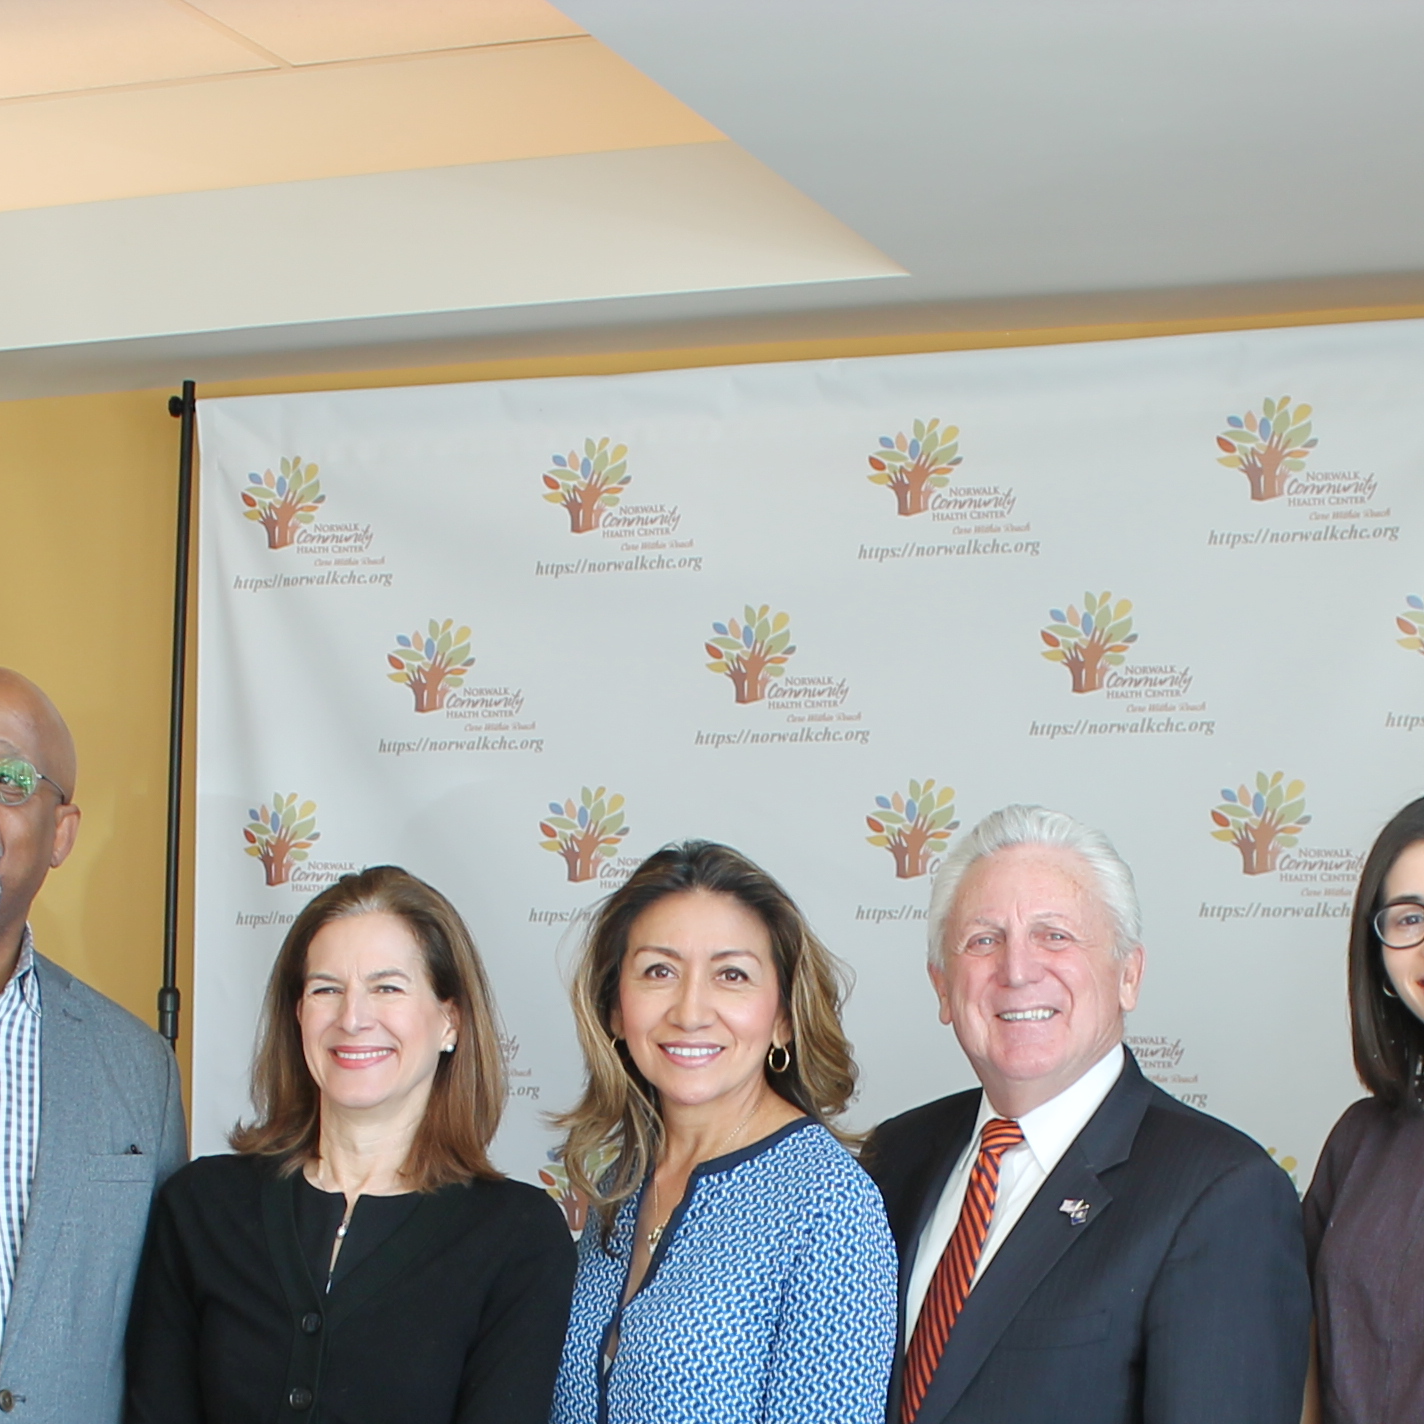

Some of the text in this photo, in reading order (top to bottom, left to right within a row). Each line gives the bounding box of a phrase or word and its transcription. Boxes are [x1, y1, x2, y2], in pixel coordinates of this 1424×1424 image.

[1306, 471, 1360, 481] NORWALK
[949, 486, 999, 496] NORWALK
[1287, 473, 1378, 499] Community
[931, 488, 1016, 515] Community
[1288, 496, 1365, 506] HEALTH CENTER
[620, 504, 666, 514] NORWALK
[603, 505, 681, 531] Community
[932, 511, 1005, 521] HEALTH CENTER
[314, 523, 359, 532] NORWALK
[297, 524, 373, 549] Community
[603, 528, 670, 538] HEALTH CENTER
[1208, 524, 1400, 549] https://norwalkchc.org
[297, 545, 364, 554] HEALTH CENTER
[858, 539, 1040, 562] https://norwalkchc.org
[536, 554, 702, 578] https://norwalkchc.org
[233, 570, 393, 592] https://norwalkchc.org
[1125, 665, 1176, 675] NORWALK
[785, 676, 833, 686] NORWALK
[1107, 667, 1192, 693] Community
[463, 687, 510, 696] NORWALK
[768, 678, 849, 704] Community
[1107, 689, 1181, 699] HEALTH CENTER
[446, 689, 524, 714] Community
[768, 700, 838, 709] HEALTH CENTER
[1029, 718, 1215, 739] https://norwalkchc.org
[695, 727, 870, 748] https://norwalkchc.org
[379, 736, 544, 756] https://norwalkchc.org
[1299, 848, 1352, 858] NORWALK
[308, 862, 355, 870] NORWALK
[1280, 874, 1357, 882] HEALTH CENTER
[1125, 1036, 1168, 1044] ORWALK
